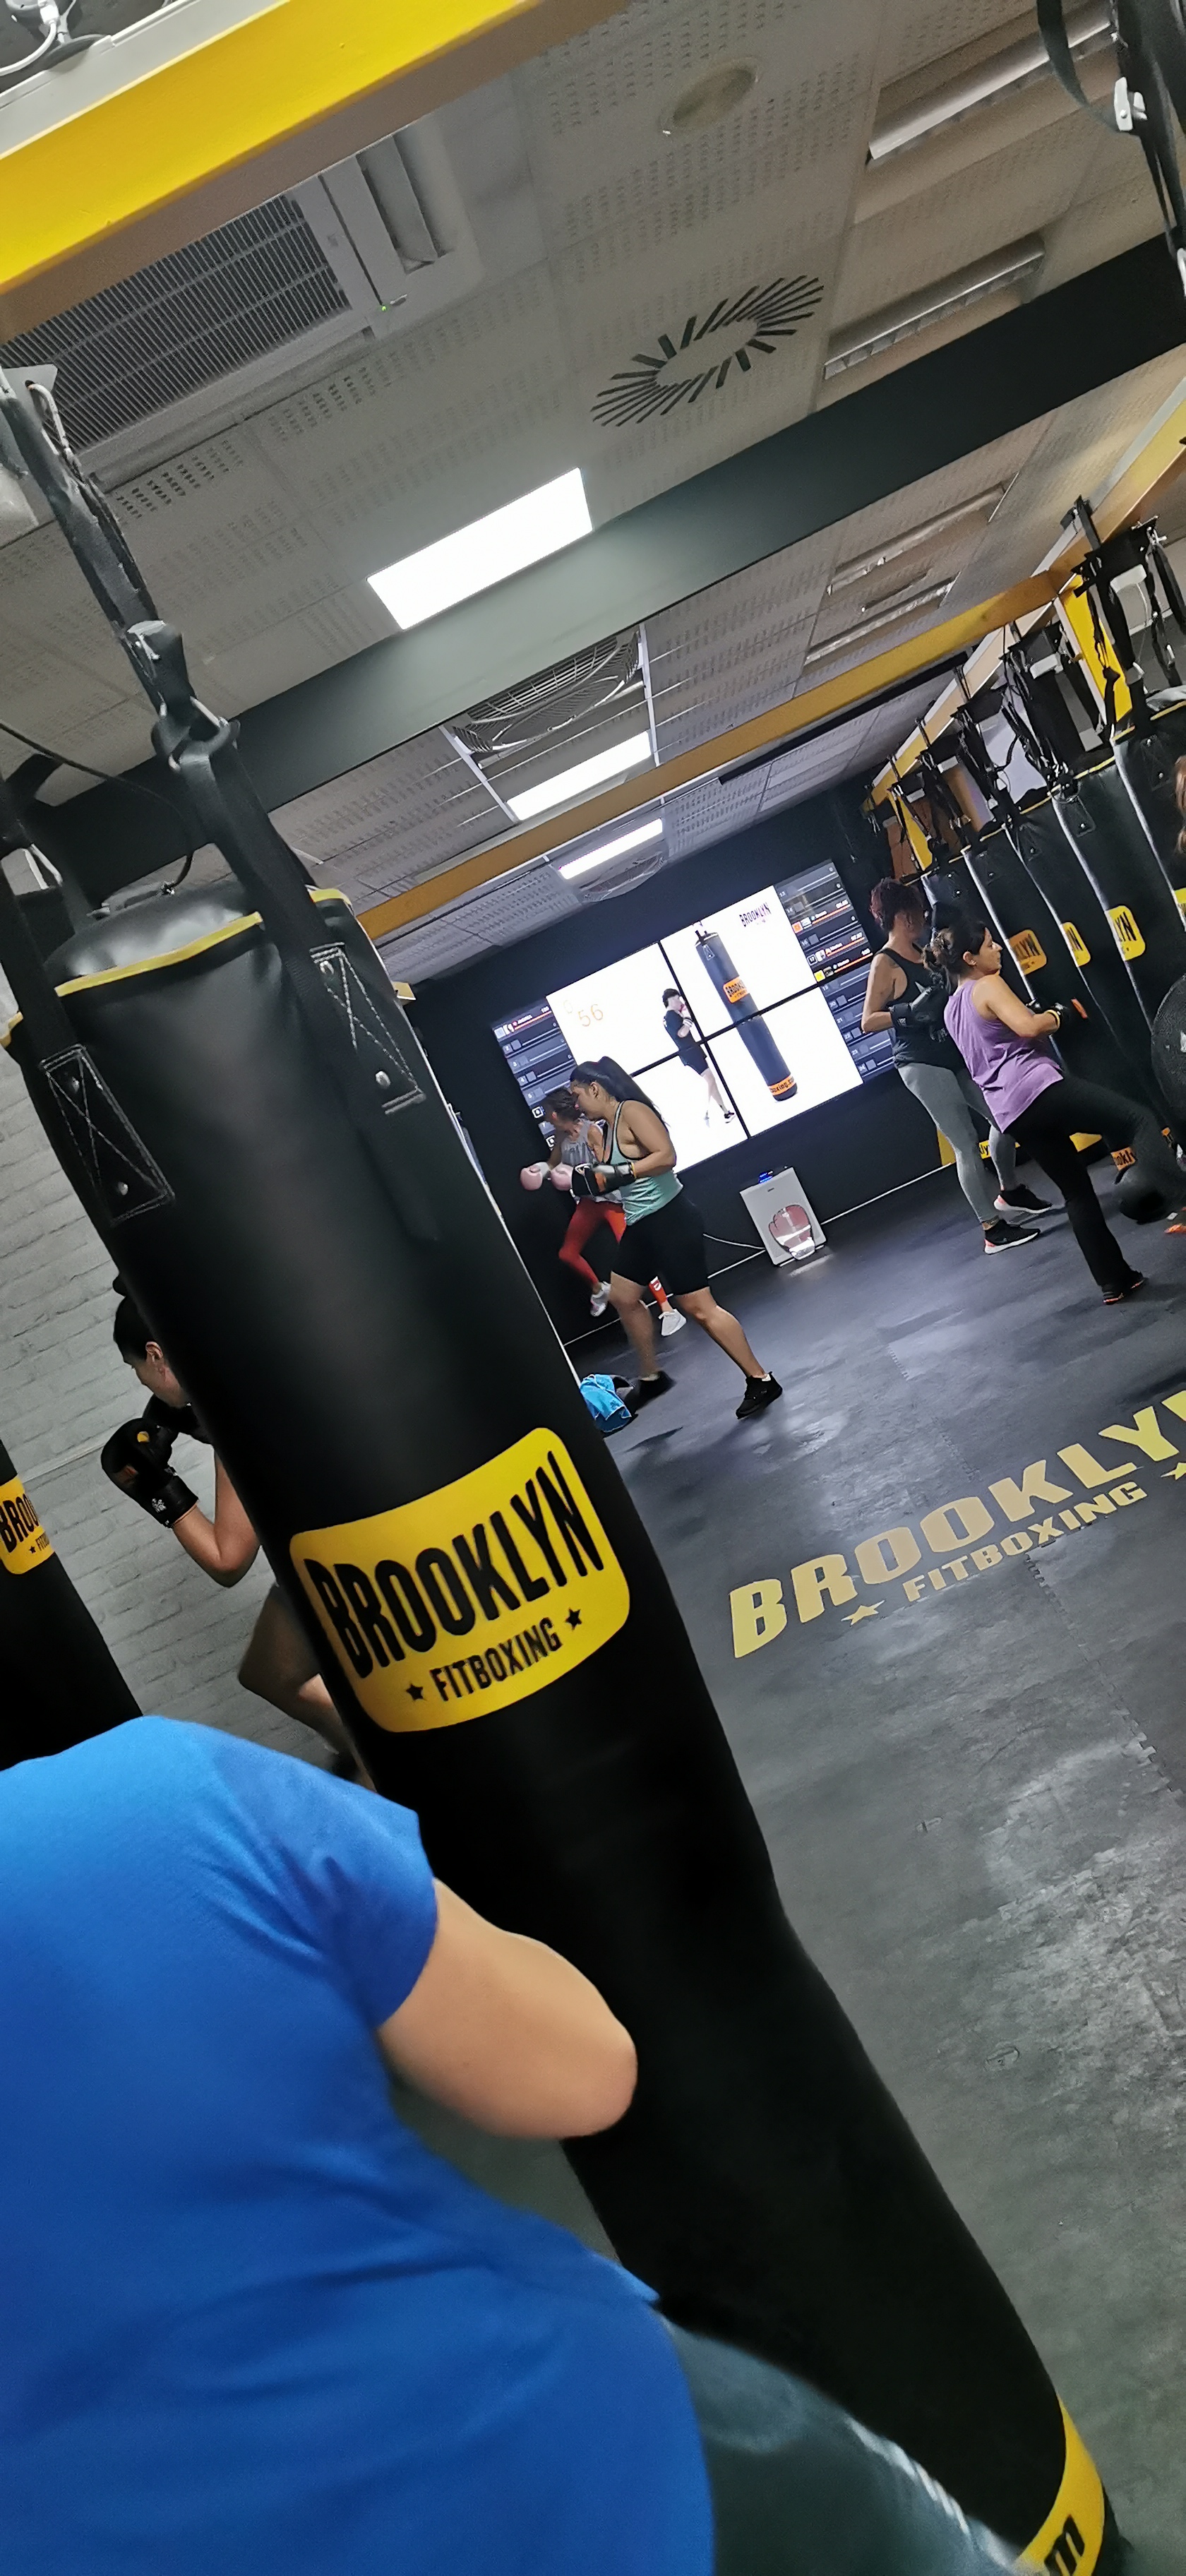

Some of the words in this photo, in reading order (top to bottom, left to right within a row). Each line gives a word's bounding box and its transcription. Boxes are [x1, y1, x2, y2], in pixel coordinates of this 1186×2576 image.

[739, 902, 772, 927] BROOKLYN
[577, 1004, 604, 1027] 56
[304, 1450, 604, 1678] BROOKLYN
[903, 1481, 1148, 1602] FITBOXING
[429, 1617, 563, 1702] FITBOXING
